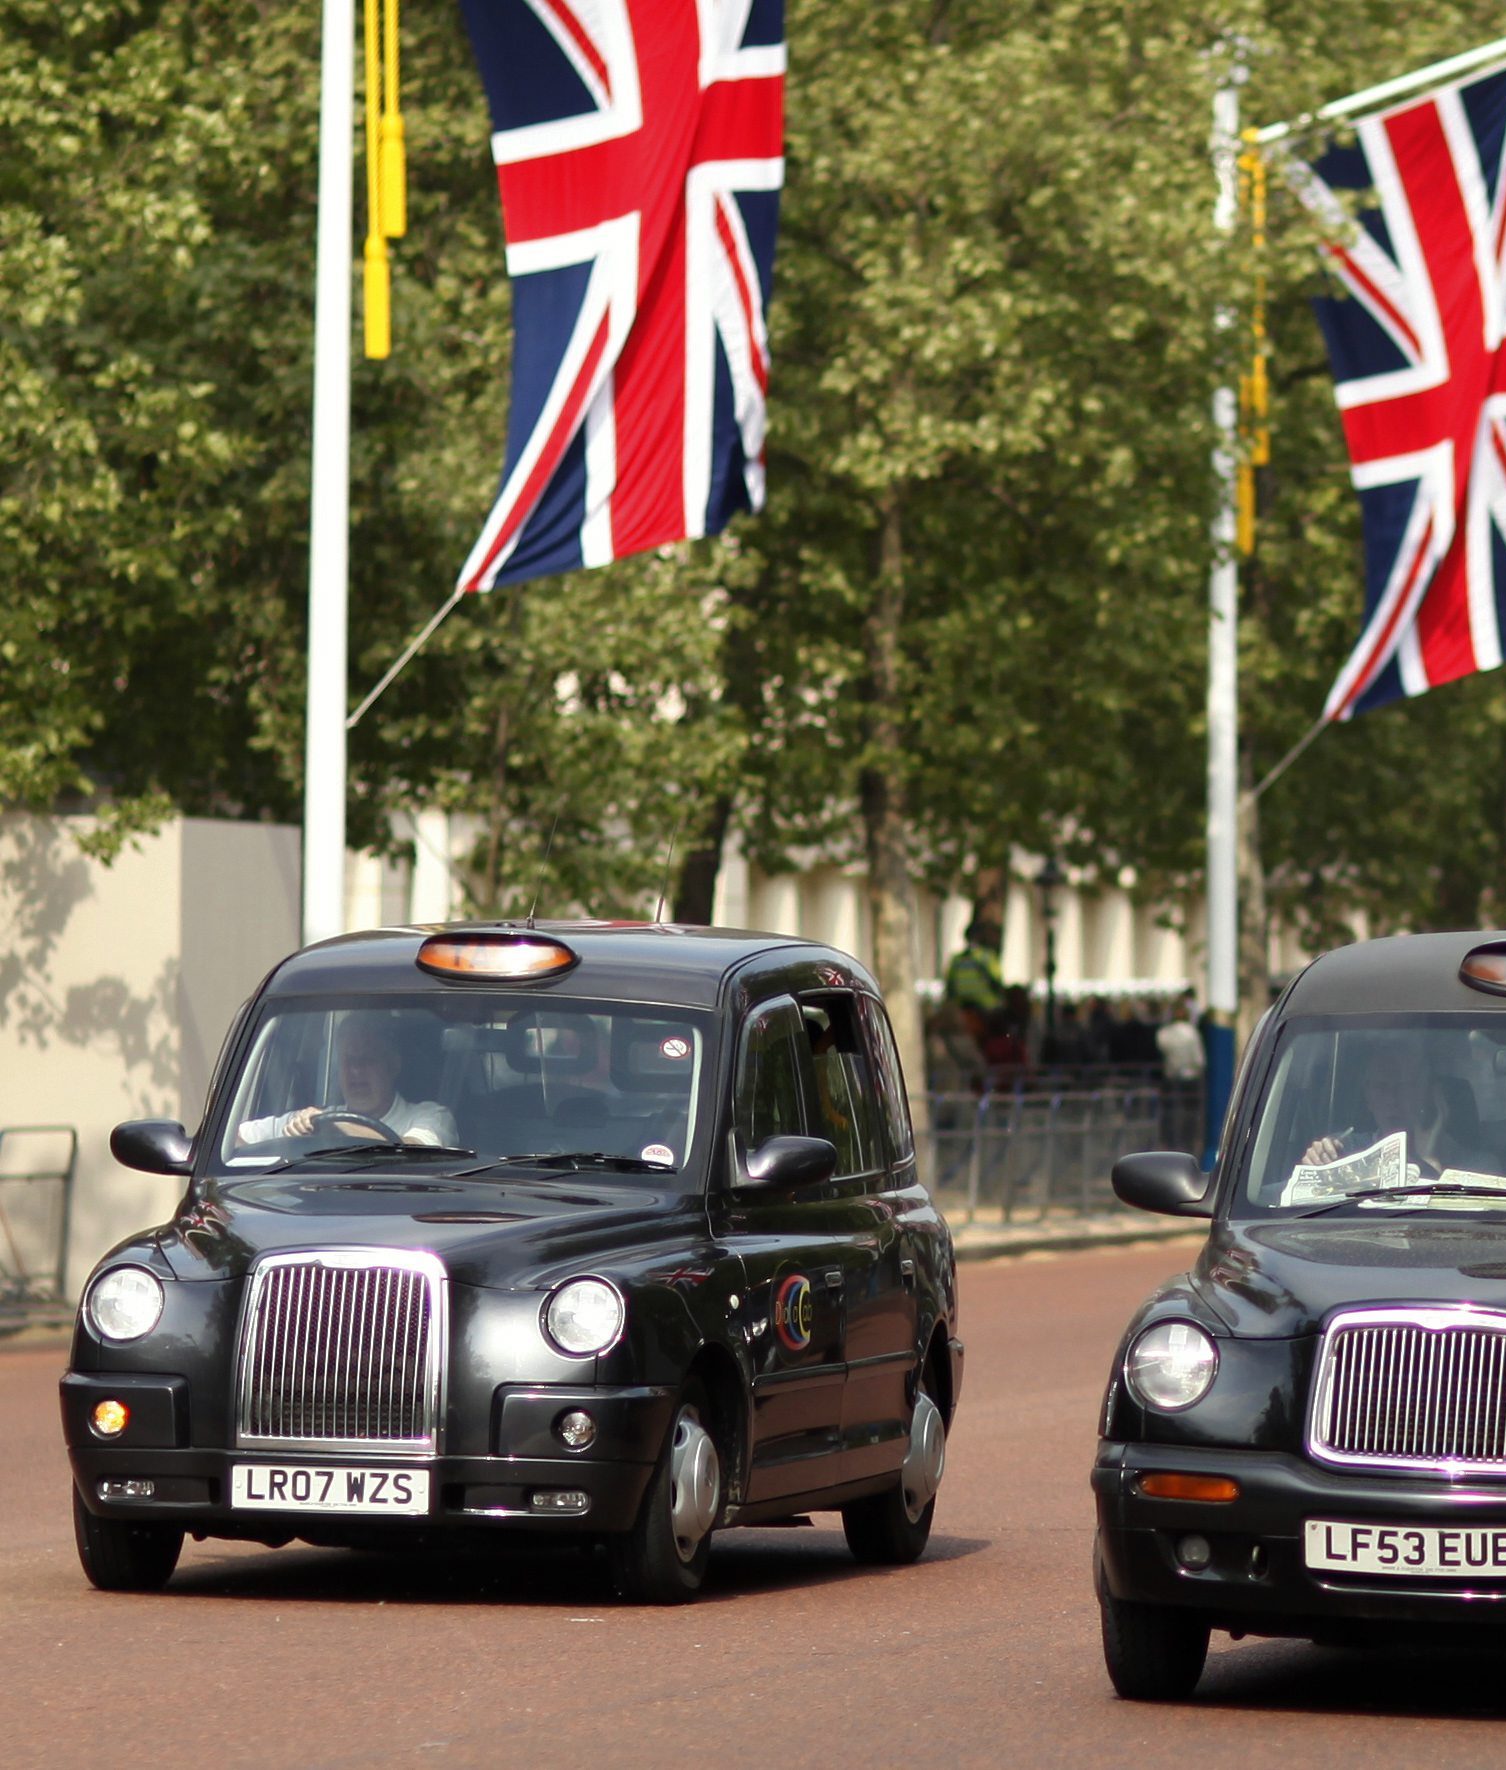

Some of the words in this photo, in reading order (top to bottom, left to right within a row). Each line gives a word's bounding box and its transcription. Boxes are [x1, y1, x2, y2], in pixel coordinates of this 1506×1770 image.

[247, 1469, 334, 1502] LR07
[346, 1471, 412, 1504] WZS
[1325, 1525, 1425, 1565] LF53
